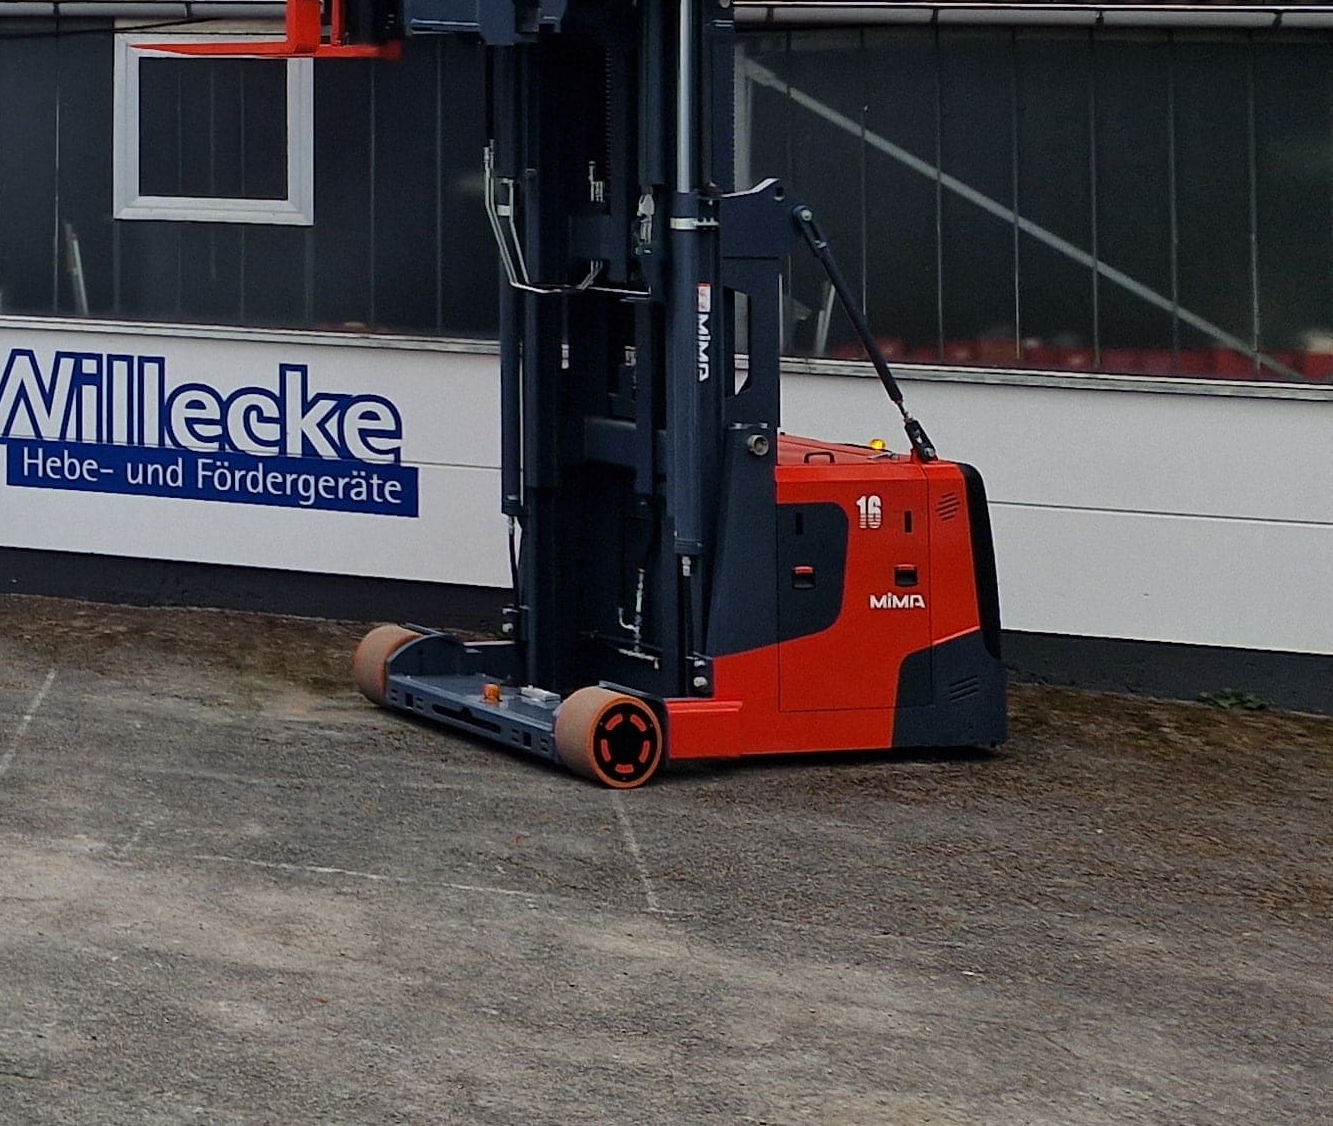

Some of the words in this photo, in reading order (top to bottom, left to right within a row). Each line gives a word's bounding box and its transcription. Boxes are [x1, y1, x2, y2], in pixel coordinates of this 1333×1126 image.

[22, 448, 113, 482] Hebe-
[126, 459, 184, 489] und
[197, 458, 403, 505] Fördergeräte
[856, 495, 882, 529] 16
